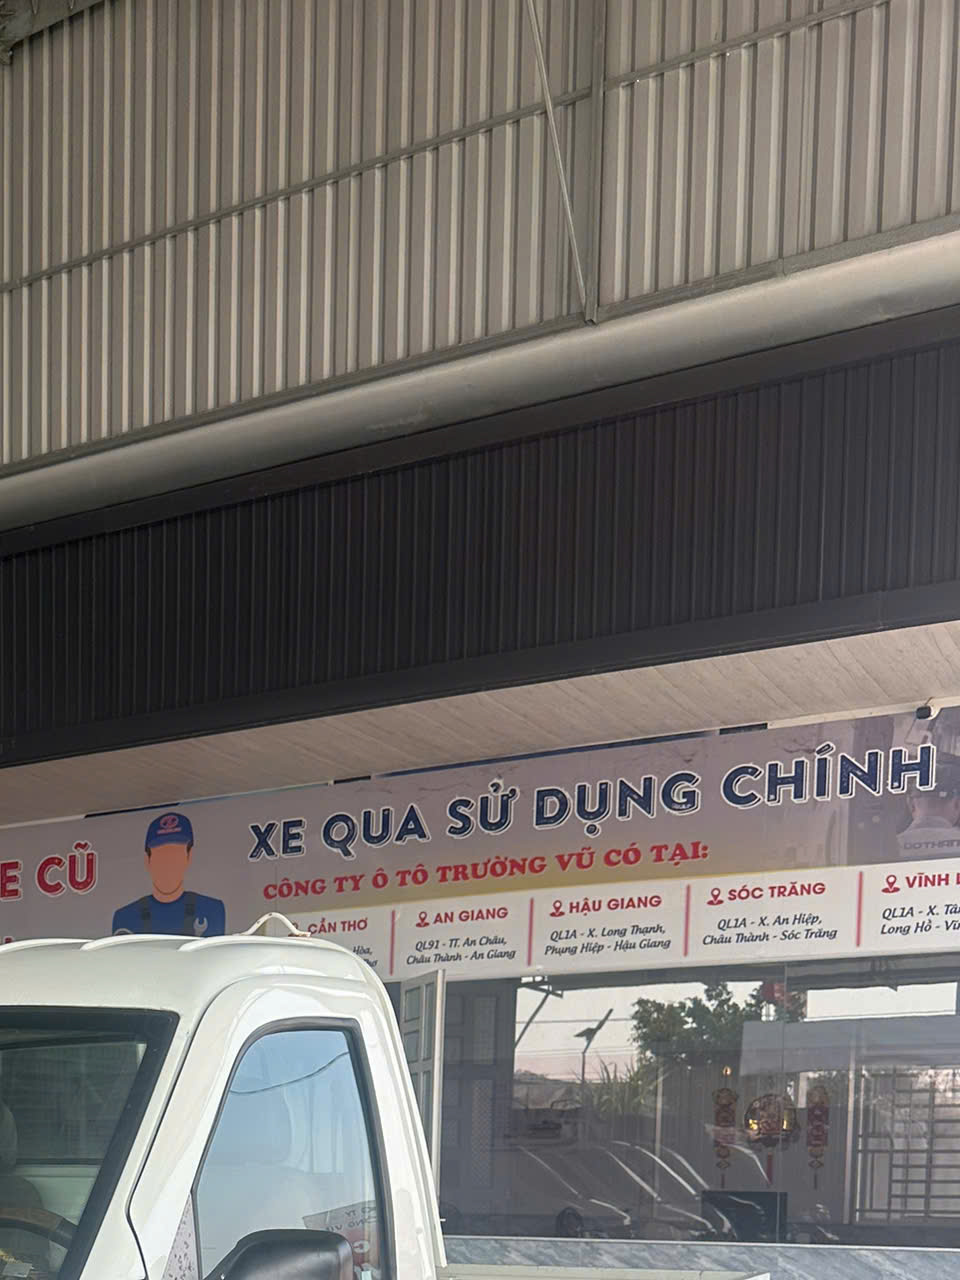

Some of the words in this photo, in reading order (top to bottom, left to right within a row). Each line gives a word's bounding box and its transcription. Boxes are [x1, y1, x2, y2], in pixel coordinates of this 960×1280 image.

[248, 818, 307, 862] XE
[321, 804, 431, 861] QUA
[446, 778, 520, 839] SỬ
[533, 770, 701, 837] DỤNG
[720, 741, 937, 809] CHÍNH
[35, 840, 98, 896] CŨ
[263, 877, 327, 900] CÔNG
[333, 874, 365, 893] TY
[372, 867, 388, 889] Ô
[395, 863, 429, 887] TÔ
[435, 855, 547, 883] TRƯỜNG
[555, 846, 595, 872] VŨ
[603, 842, 641, 867] CÓ
[650, 840, 709, 866] TẠI:
[905, 871, 949, 890] VĨNH
[728, 884, 764, 901] SÓC
[768, 881, 826, 898] TRĂNG
[569, 899, 602, 917] HẬU
[607, 894, 662, 911] GIANG
[882, 906, 914, 921] QL1A
[927, 904, 940, 916] X.
[944, 903, 960, 915] Tâ
[340, 916, 368, 932] THƠ
[433, 910, 455, 925] AN
[459, 906, 509, 922] GIANG
[717, 917, 747, 931] QL1A
[758, 916, 770, 927] X.
[772, 915, 790, 926] An
[792, 912, 822, 926] Hiệp,
[550, 929, 577, 942] QL1A
[587, 928, 598, 938] X.
[601, 927, 628, 938] Long
[702, 934, 732, 945] Châu
[735, 932, 770, 943] Thành
[780, 930, 801, 941] Sóc
[804, 928, 838, 940] Trăng
[881, 924, 911, 936] Long
[914, 919, 932, 934] Hồ
[415, 940, 440, 952] QL91
[463, 937, 476, 947] An
[544, 944, 578, 956] Phụng
[580, 942, 604, 954] Hiệp
[613, 939, 637, 951] Hậu
[639, 938, 672, 949] Giang
[433, 952, 462, 963] Thành
[470, 951, 484, 961] An
[486, 949, 516, 960] Giang
